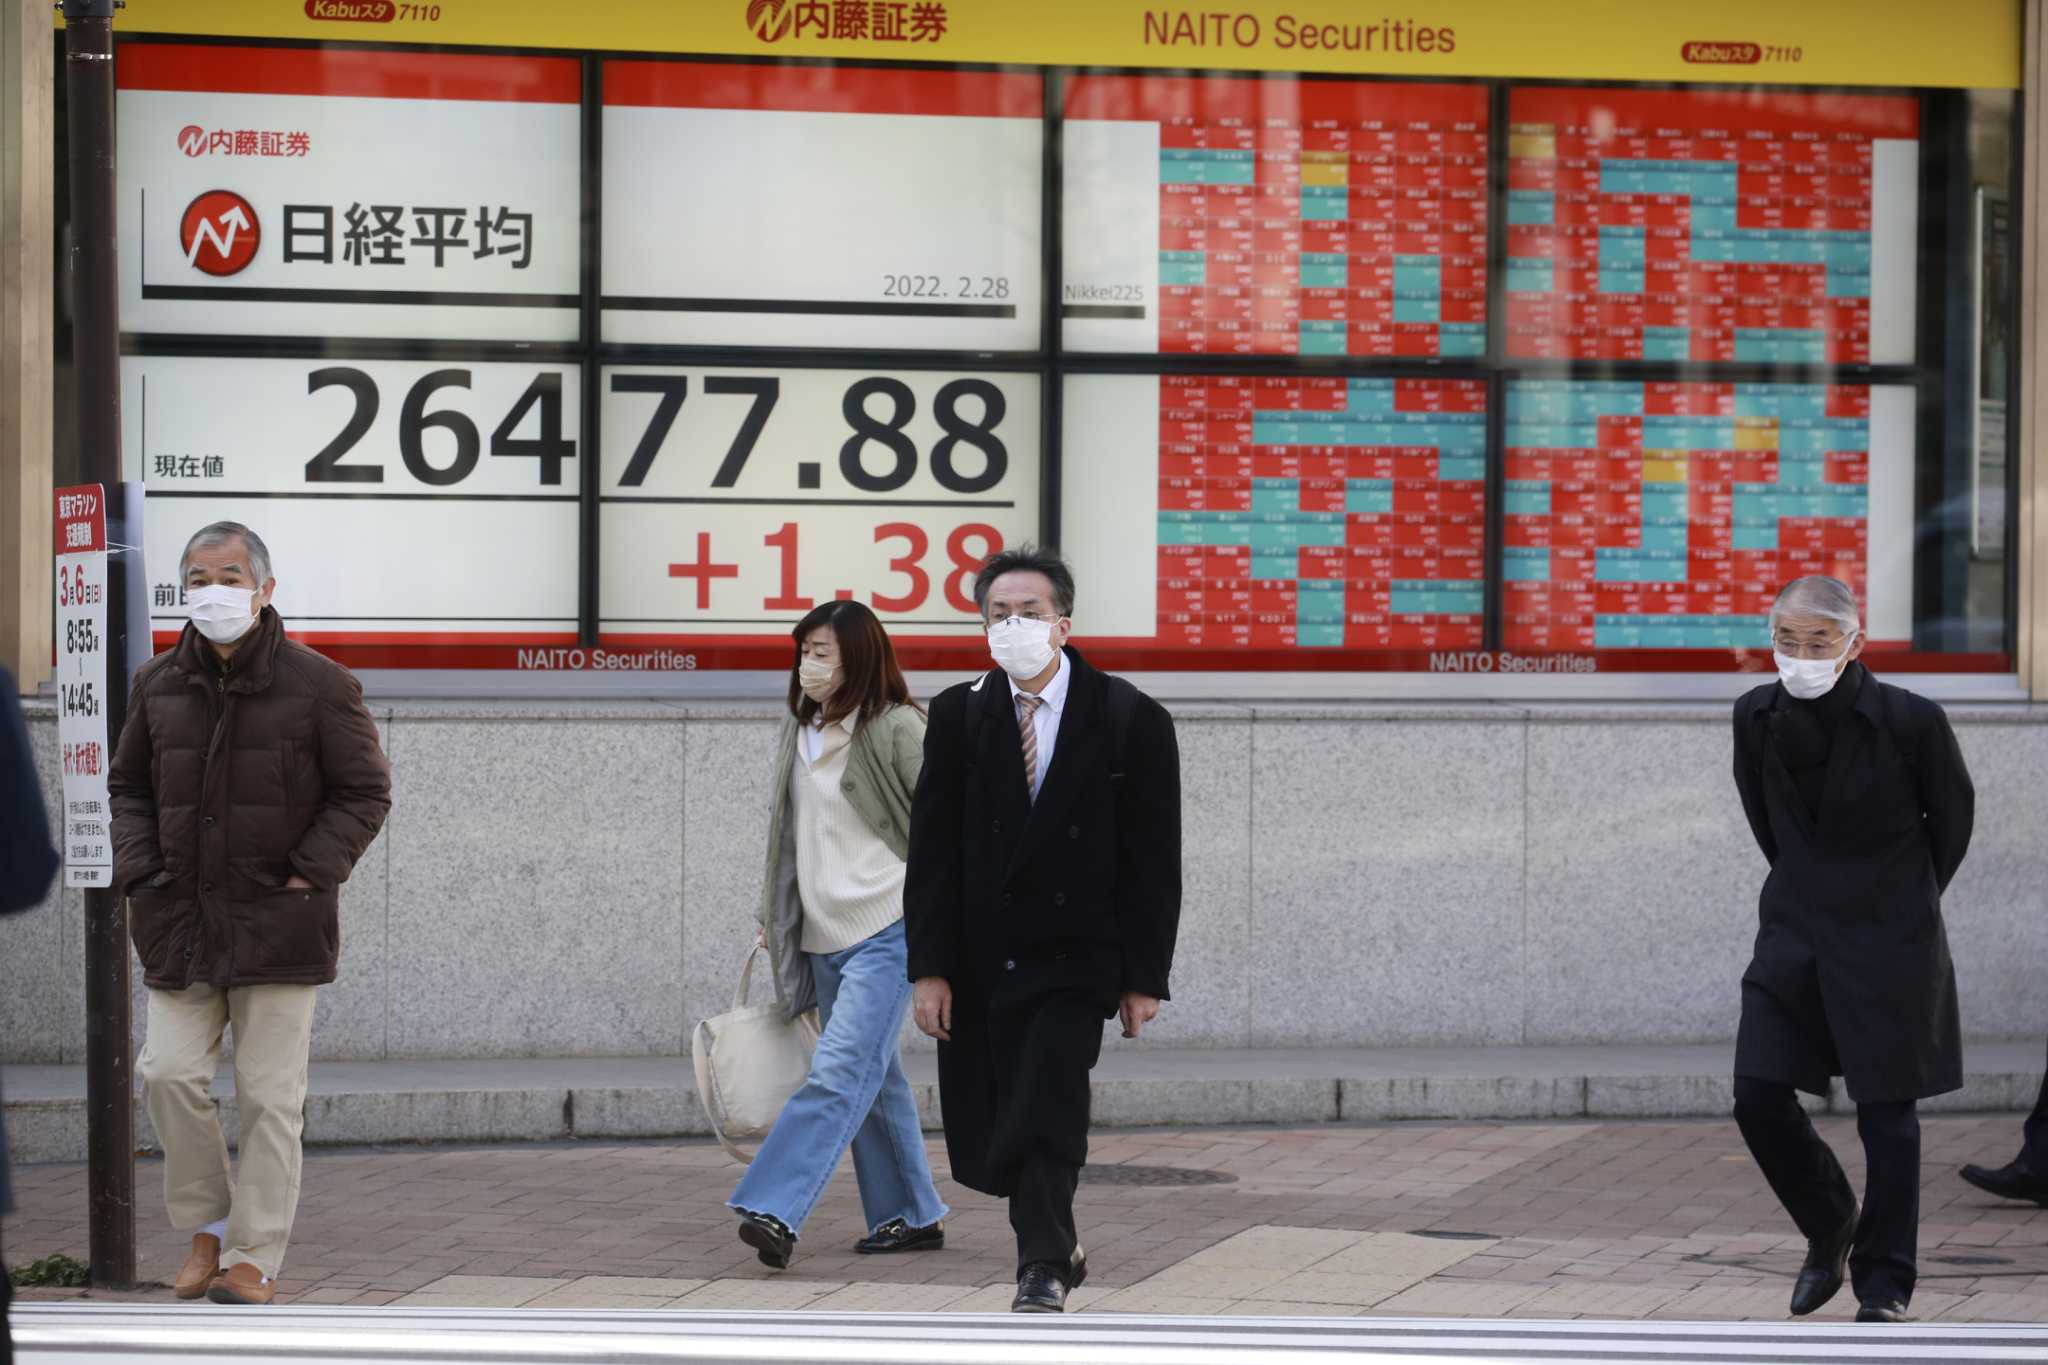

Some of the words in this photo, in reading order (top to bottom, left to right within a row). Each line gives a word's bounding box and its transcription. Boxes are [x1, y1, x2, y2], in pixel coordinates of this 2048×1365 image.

[313, 0, 387, 18] Kabuスタ
[400, 4, 440, 21] 7110
[795, 0, 947, 42] 内藤証券
[1144, 11, 1260, 47] NAITO
[1274, 16, 1456, 53] Securities
[1764, 46, 1803, 62] 7110
[209, 129, 311, 157] 内藤証券
[282, 202, 533, 269] 日経平均
[1064, 284, 1144, 301] Nikkei225
[154, 454, 225, 478] 現在値
[668, 521, 1005, 614] +1.38
[517, 649, 585, 669] NAITO
[592, 649, 697, 669] Securities
[1429, 652, 1493, 672] NAITO
[1499, 652, 1597, 672] Securities
